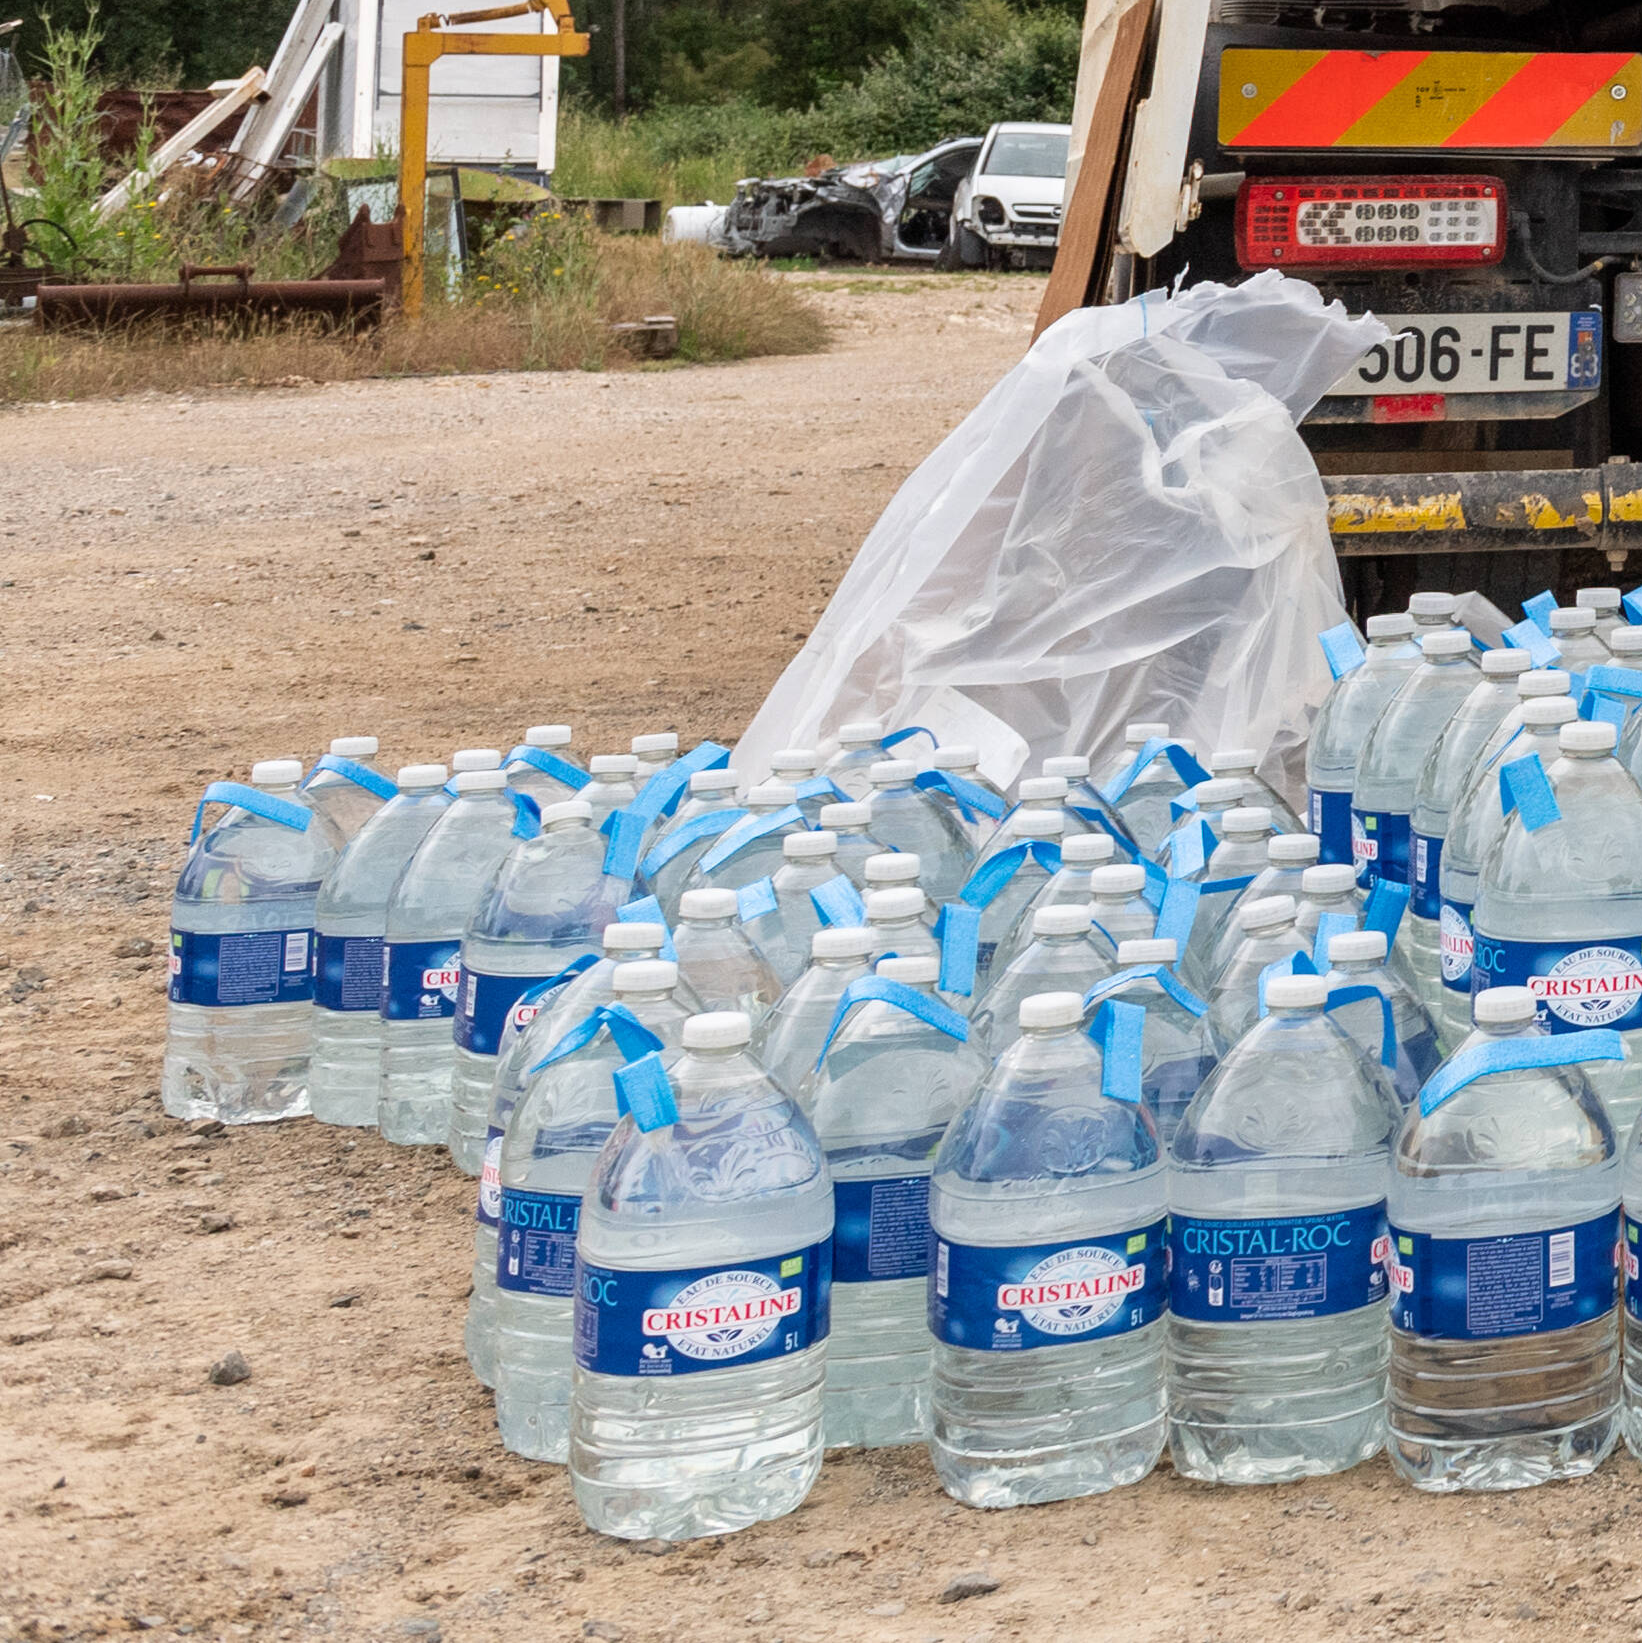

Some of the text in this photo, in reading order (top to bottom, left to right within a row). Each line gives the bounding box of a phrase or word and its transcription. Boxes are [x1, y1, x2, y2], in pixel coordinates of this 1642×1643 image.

[1183, 1221, 1351, 1255] CRISTAL-ROC
[1001, 1267, 1143, 1306] CRISTALINE
[646, 1291, 798, 1332] CRISTALINE
